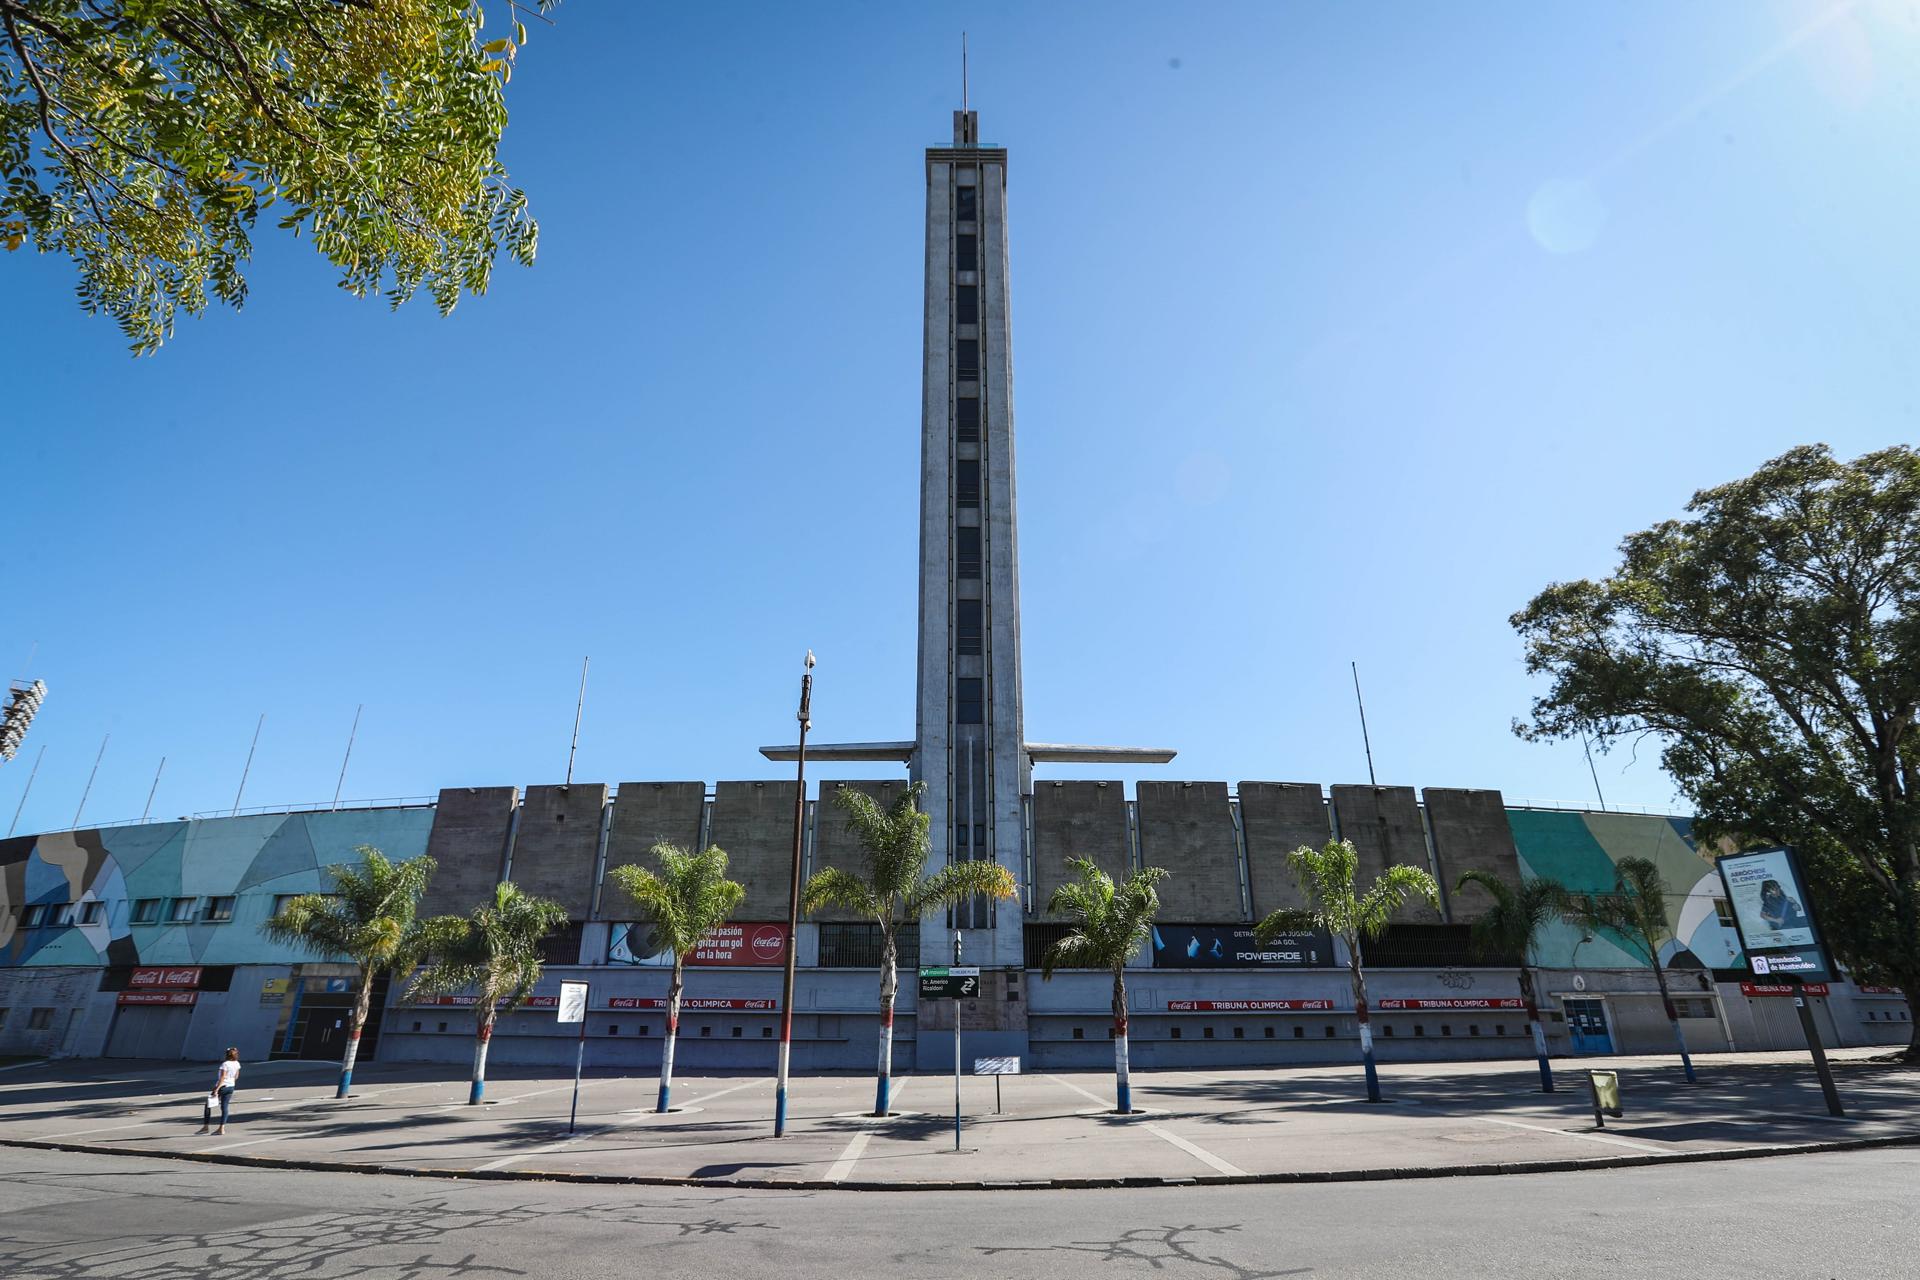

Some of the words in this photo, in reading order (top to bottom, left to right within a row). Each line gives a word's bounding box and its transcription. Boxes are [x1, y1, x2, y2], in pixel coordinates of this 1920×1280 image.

[718, 925, 743, 937] pasión
[731, 938, 743, 950] gol
[696, 951, 706, 959] en
[707, 949, 714, 959] la
[715, 949, 732, 959] hora
[1236, 951, 1301, 961] POWERADE
[1770, 963, 1778, 971] de
[653, 1000, 691, 1008] TRINA
[691, 1000, 732, 1008] OLIMPICA
[1211, 1001, 1249, 1009] TRIBUNA
[1249, 1001, 1290, 1009] OLIMPICA
[1418, 1000, 1452, 1008] TRIBUNA
[1453, 1000, 1490, 1008] OLIMPICA
